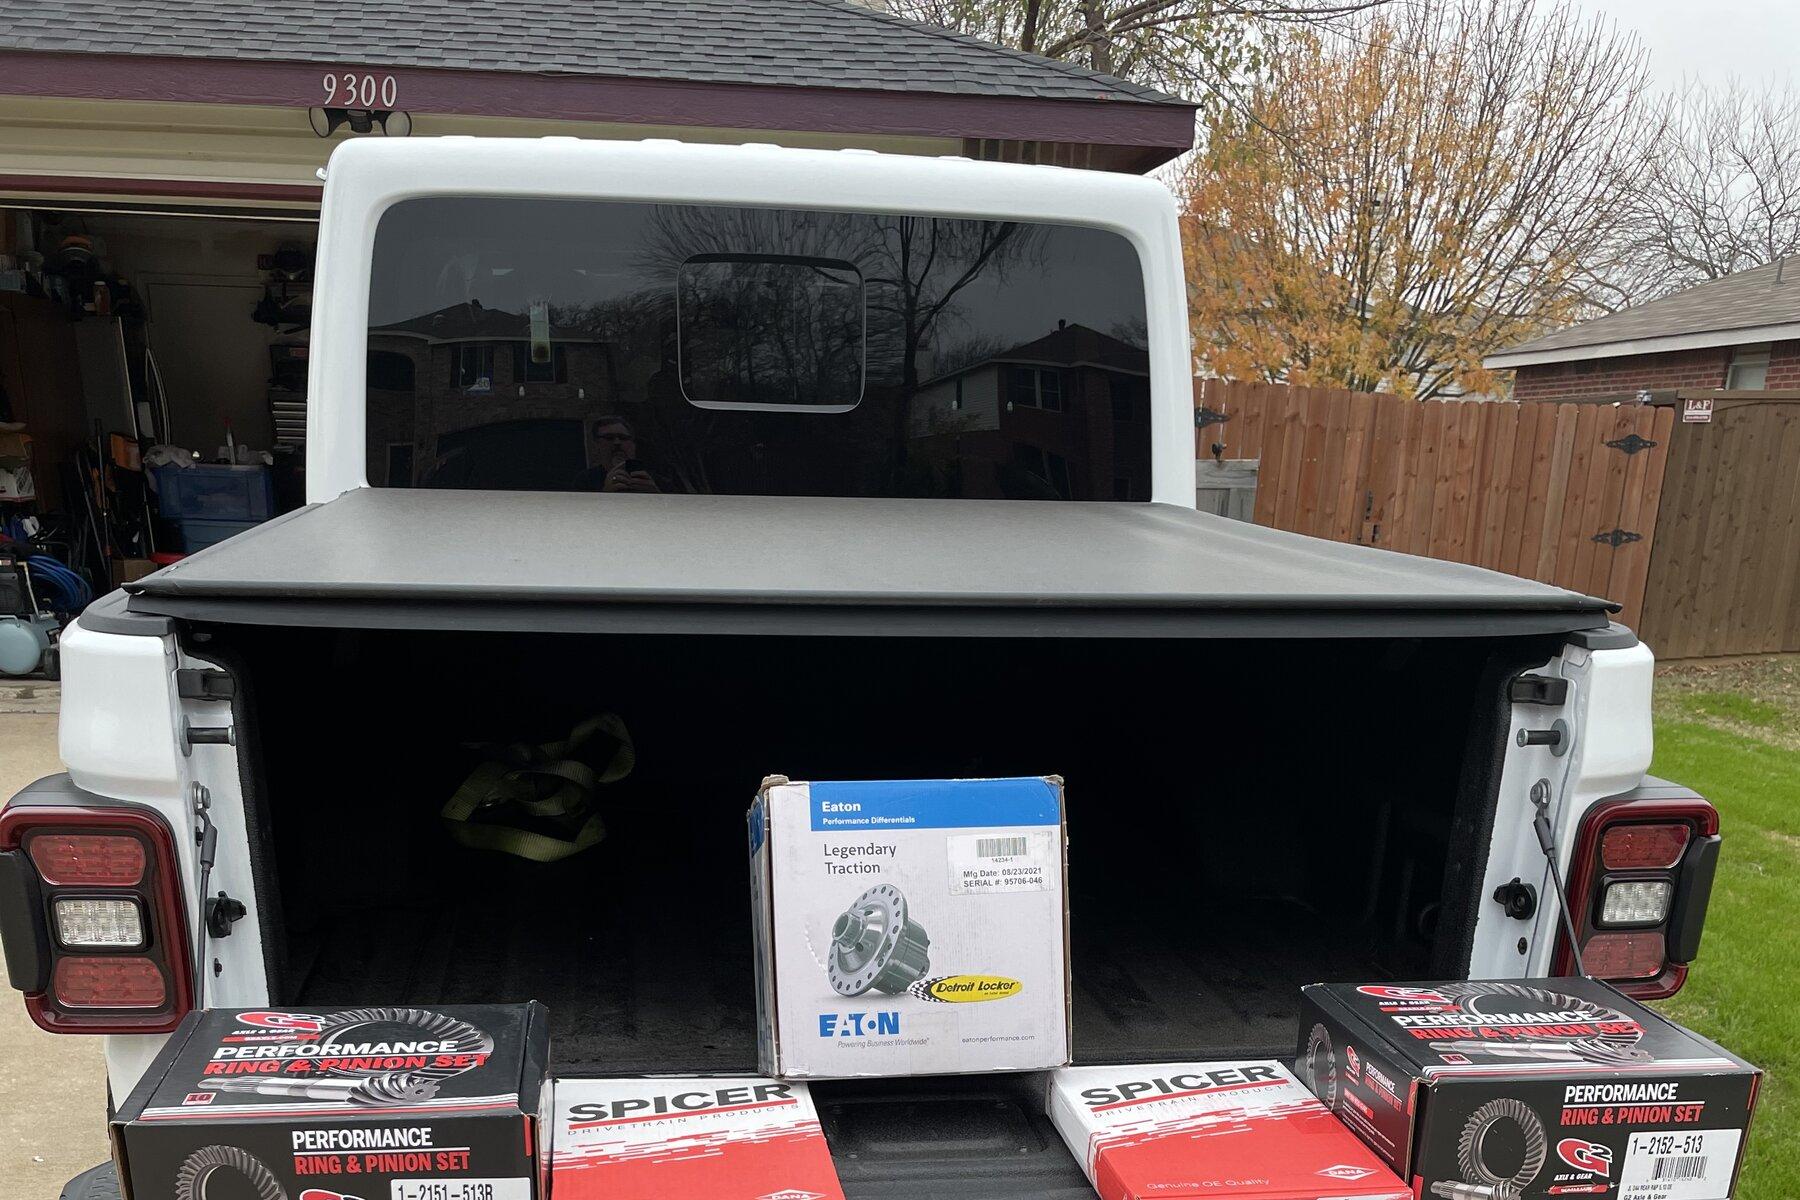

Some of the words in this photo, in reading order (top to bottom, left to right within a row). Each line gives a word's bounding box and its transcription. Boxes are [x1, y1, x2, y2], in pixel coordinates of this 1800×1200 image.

[322, 73, 397, 107] 9300
[821, 801, 861, 812] Eaton
[822, 817, 870, 825] Performance
[870, 816, 916, 824] Differentials
[824, 842, 896, 859] Legendary
[824, 861, 880, 874] Traction
[963, 870, 978, 879] Mfg
[979, 869, 1000, 878] Date:
[1001, 867, 1042, 876] 08/23/2021
[963, 879, 993, 888] SERIAL
[1004, 876, 1043, 886] 95706-046
[936, 981, 975, 993] Detroit
[977, 981, 1015, 991] Locker
[235, 1012, 326, 1031] G2
[818, 1011, 900, 1037] EATON
[1391, 1010, 1596, 1027] PERFORMANCE
[961, 1034, 1035, 1044] eatonperformance.com
[1407, 1027, 1473, 1040] RING
[1479, 1027, 1502, 1039] &
[1501, 1025, 1597, 1038] PINION
[1596, 1022, 1647, 1034] SET
[212, 1040, 459, 1059] PERFORMANCE
[837, 1041, 866, 1049] Powering
[866, 1040, 894, 1048] Business
[203, 1059, 281, 1075] RING
[286, 1059, 312, 1073] &
[320, 1056, 428, 1071] PINION
[434, 1053, 491, 1068] SET
[1081, 1065, 1283, 1105] SPICER
[1564, 1083, 1679, 1103] PERFORMANCE
[566, 1083, 798, 1122] SPICER
[1093, 1096, 1197, 1118] DRIVETRAIN
[1207, 1084, 1295, 1099] PRODUCTS
[568, 1118, 687, 1135] DRIVETRAIN
[700, 1104, 799, 1120] PRODUCTS
[1560, 1108, 1599, 1126] RING
[1601, 1107, 1614, 1124] &
[1616, 1106, 1672, 1124] PINION
[1674, 1105, 1704, 1123] SET
[292, 1127, 433, 1150] PERFORMANCE
[1632, 1135, 1703, 1156] 1-2152-513
[294, 1155, 342, 1175] RING
[346, 1154, 362, 1173] &
[365, 1152, 432, 1173] PINION
[436, 1151, 470, 1171] SET
[1556, 1138, 1613, 1177] G2
[1146, 1181, 1200, 1190] Genuine
[1224, 1177, 1270, 1187] Quality
[772, 1193, 811, 1200] DANA
